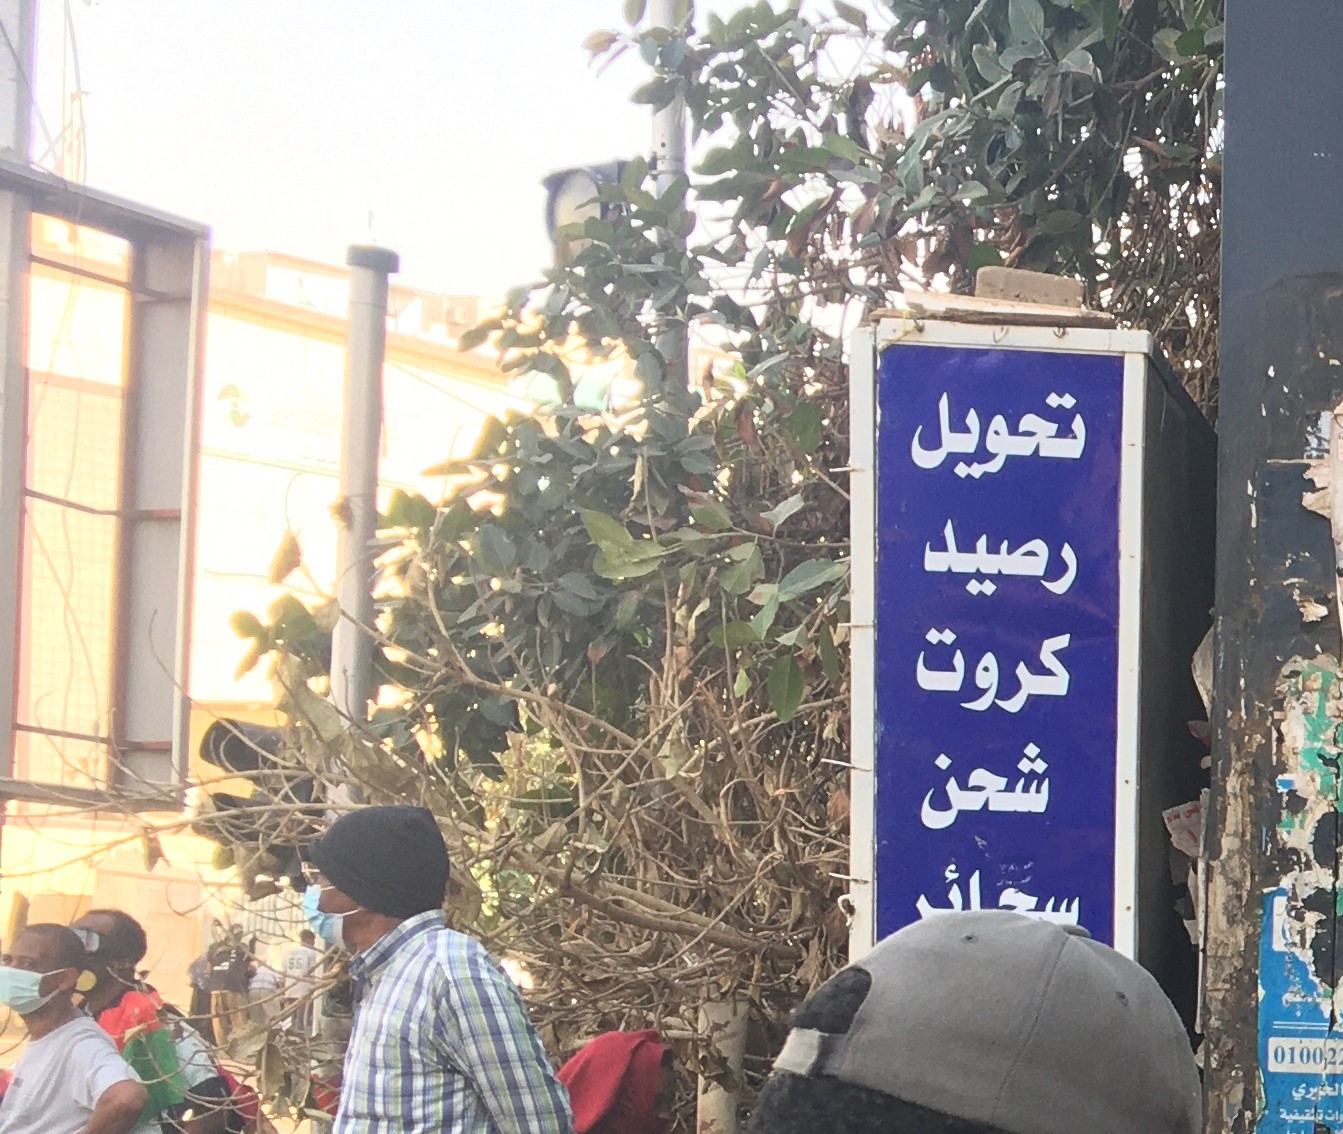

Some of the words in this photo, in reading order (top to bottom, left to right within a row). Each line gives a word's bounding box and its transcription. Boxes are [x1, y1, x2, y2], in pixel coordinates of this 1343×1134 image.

[911, 391, 1086, 479] تحويل
[924, 519, 1077, 596] رصيد
[916, 628, 1071, 713] كروت
[920, 742, 1050, 830] شحن
